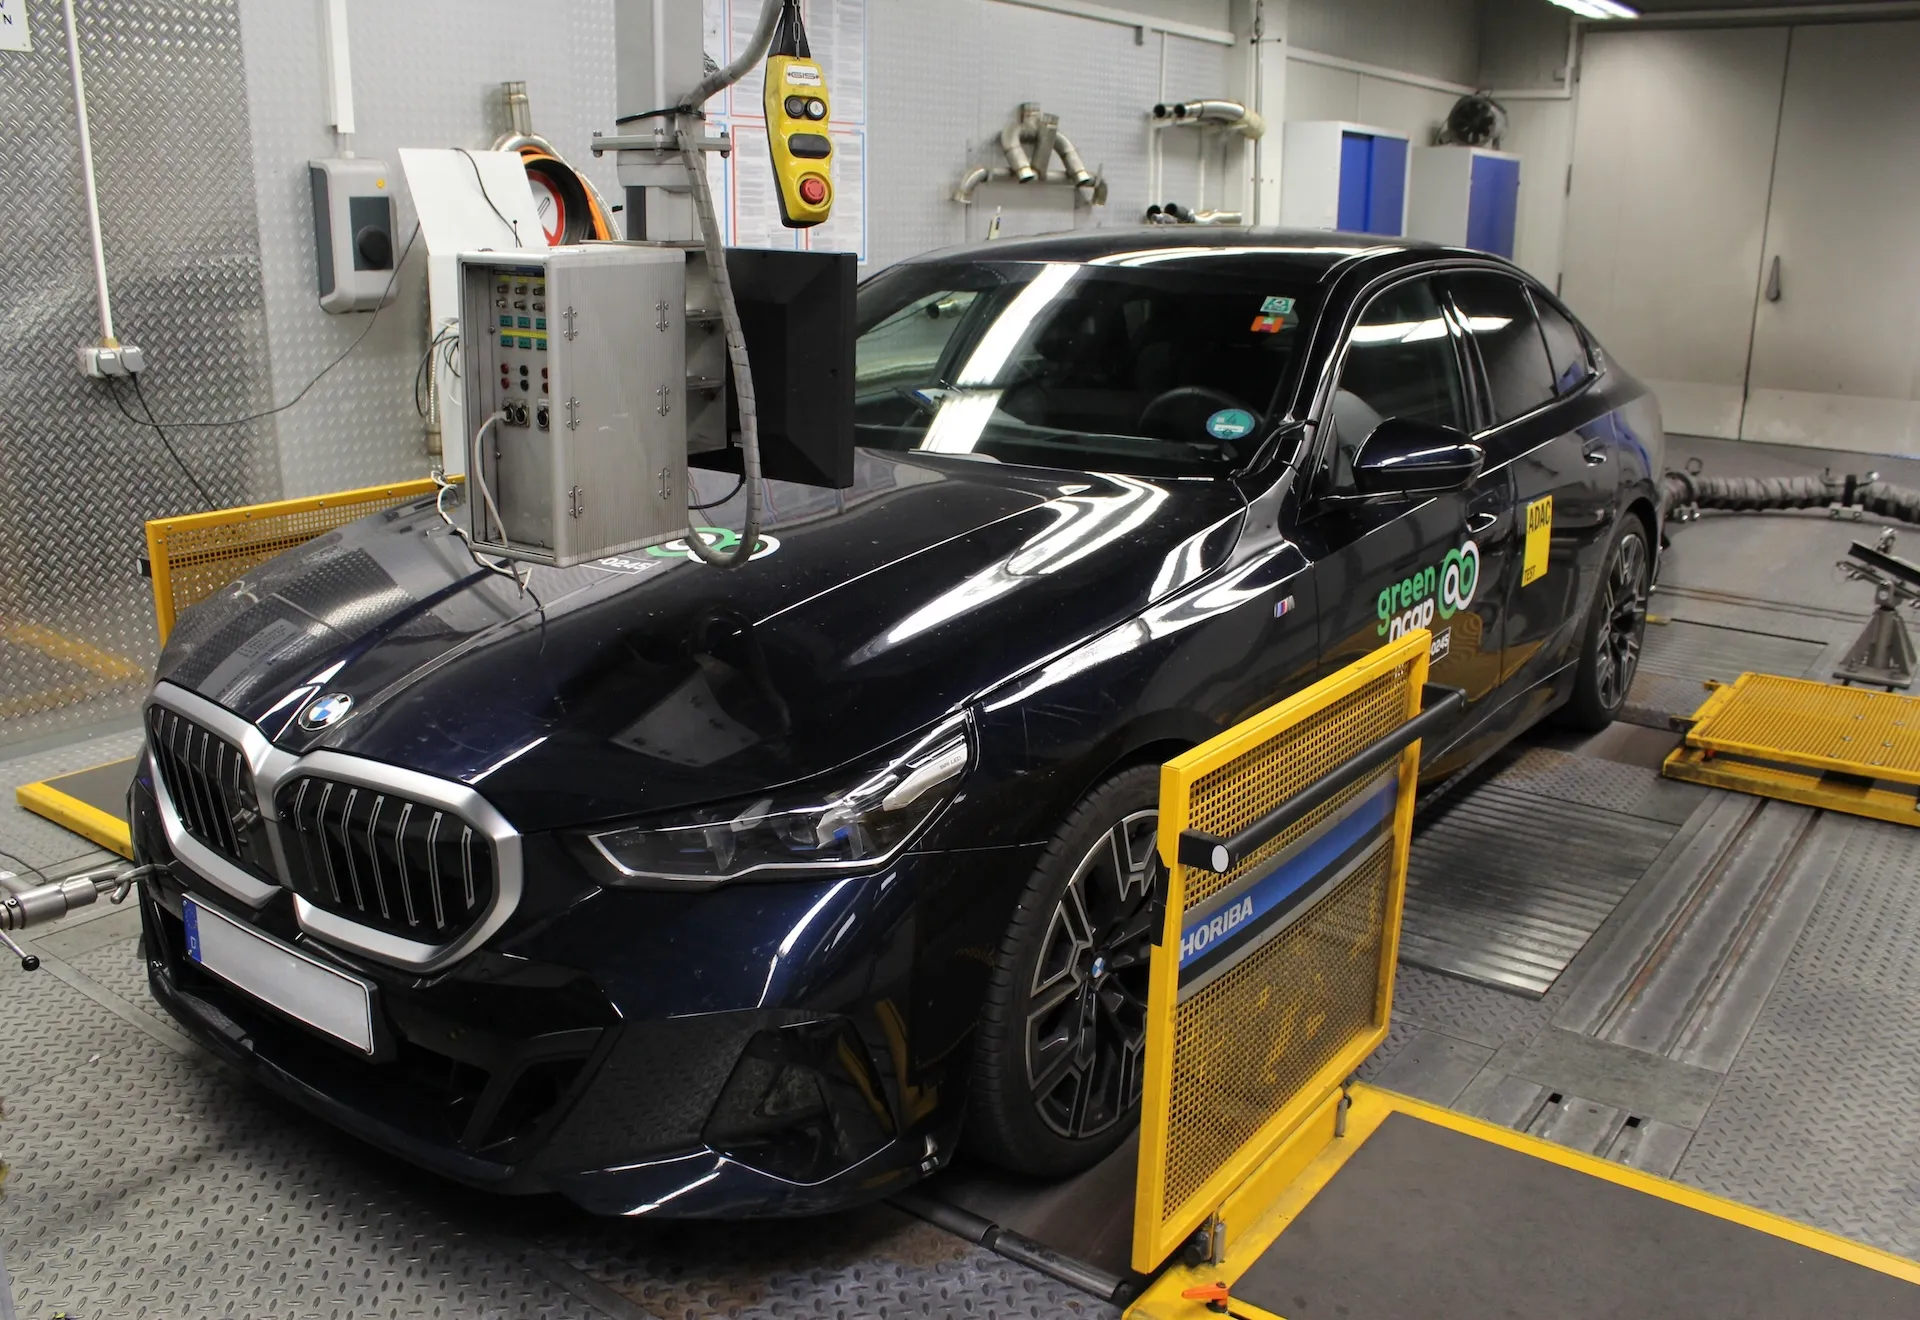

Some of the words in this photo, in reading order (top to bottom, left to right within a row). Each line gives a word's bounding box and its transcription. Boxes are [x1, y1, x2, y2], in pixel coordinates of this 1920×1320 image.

[1528, 500, 1551, 534] ADAC
[1524, 565, 1536, 582] TEST
[1377, 566, 1436, 636] green
[1388, 598, 1435, 643] ncap
[1179, 895, 1253, 962] HORIBA
